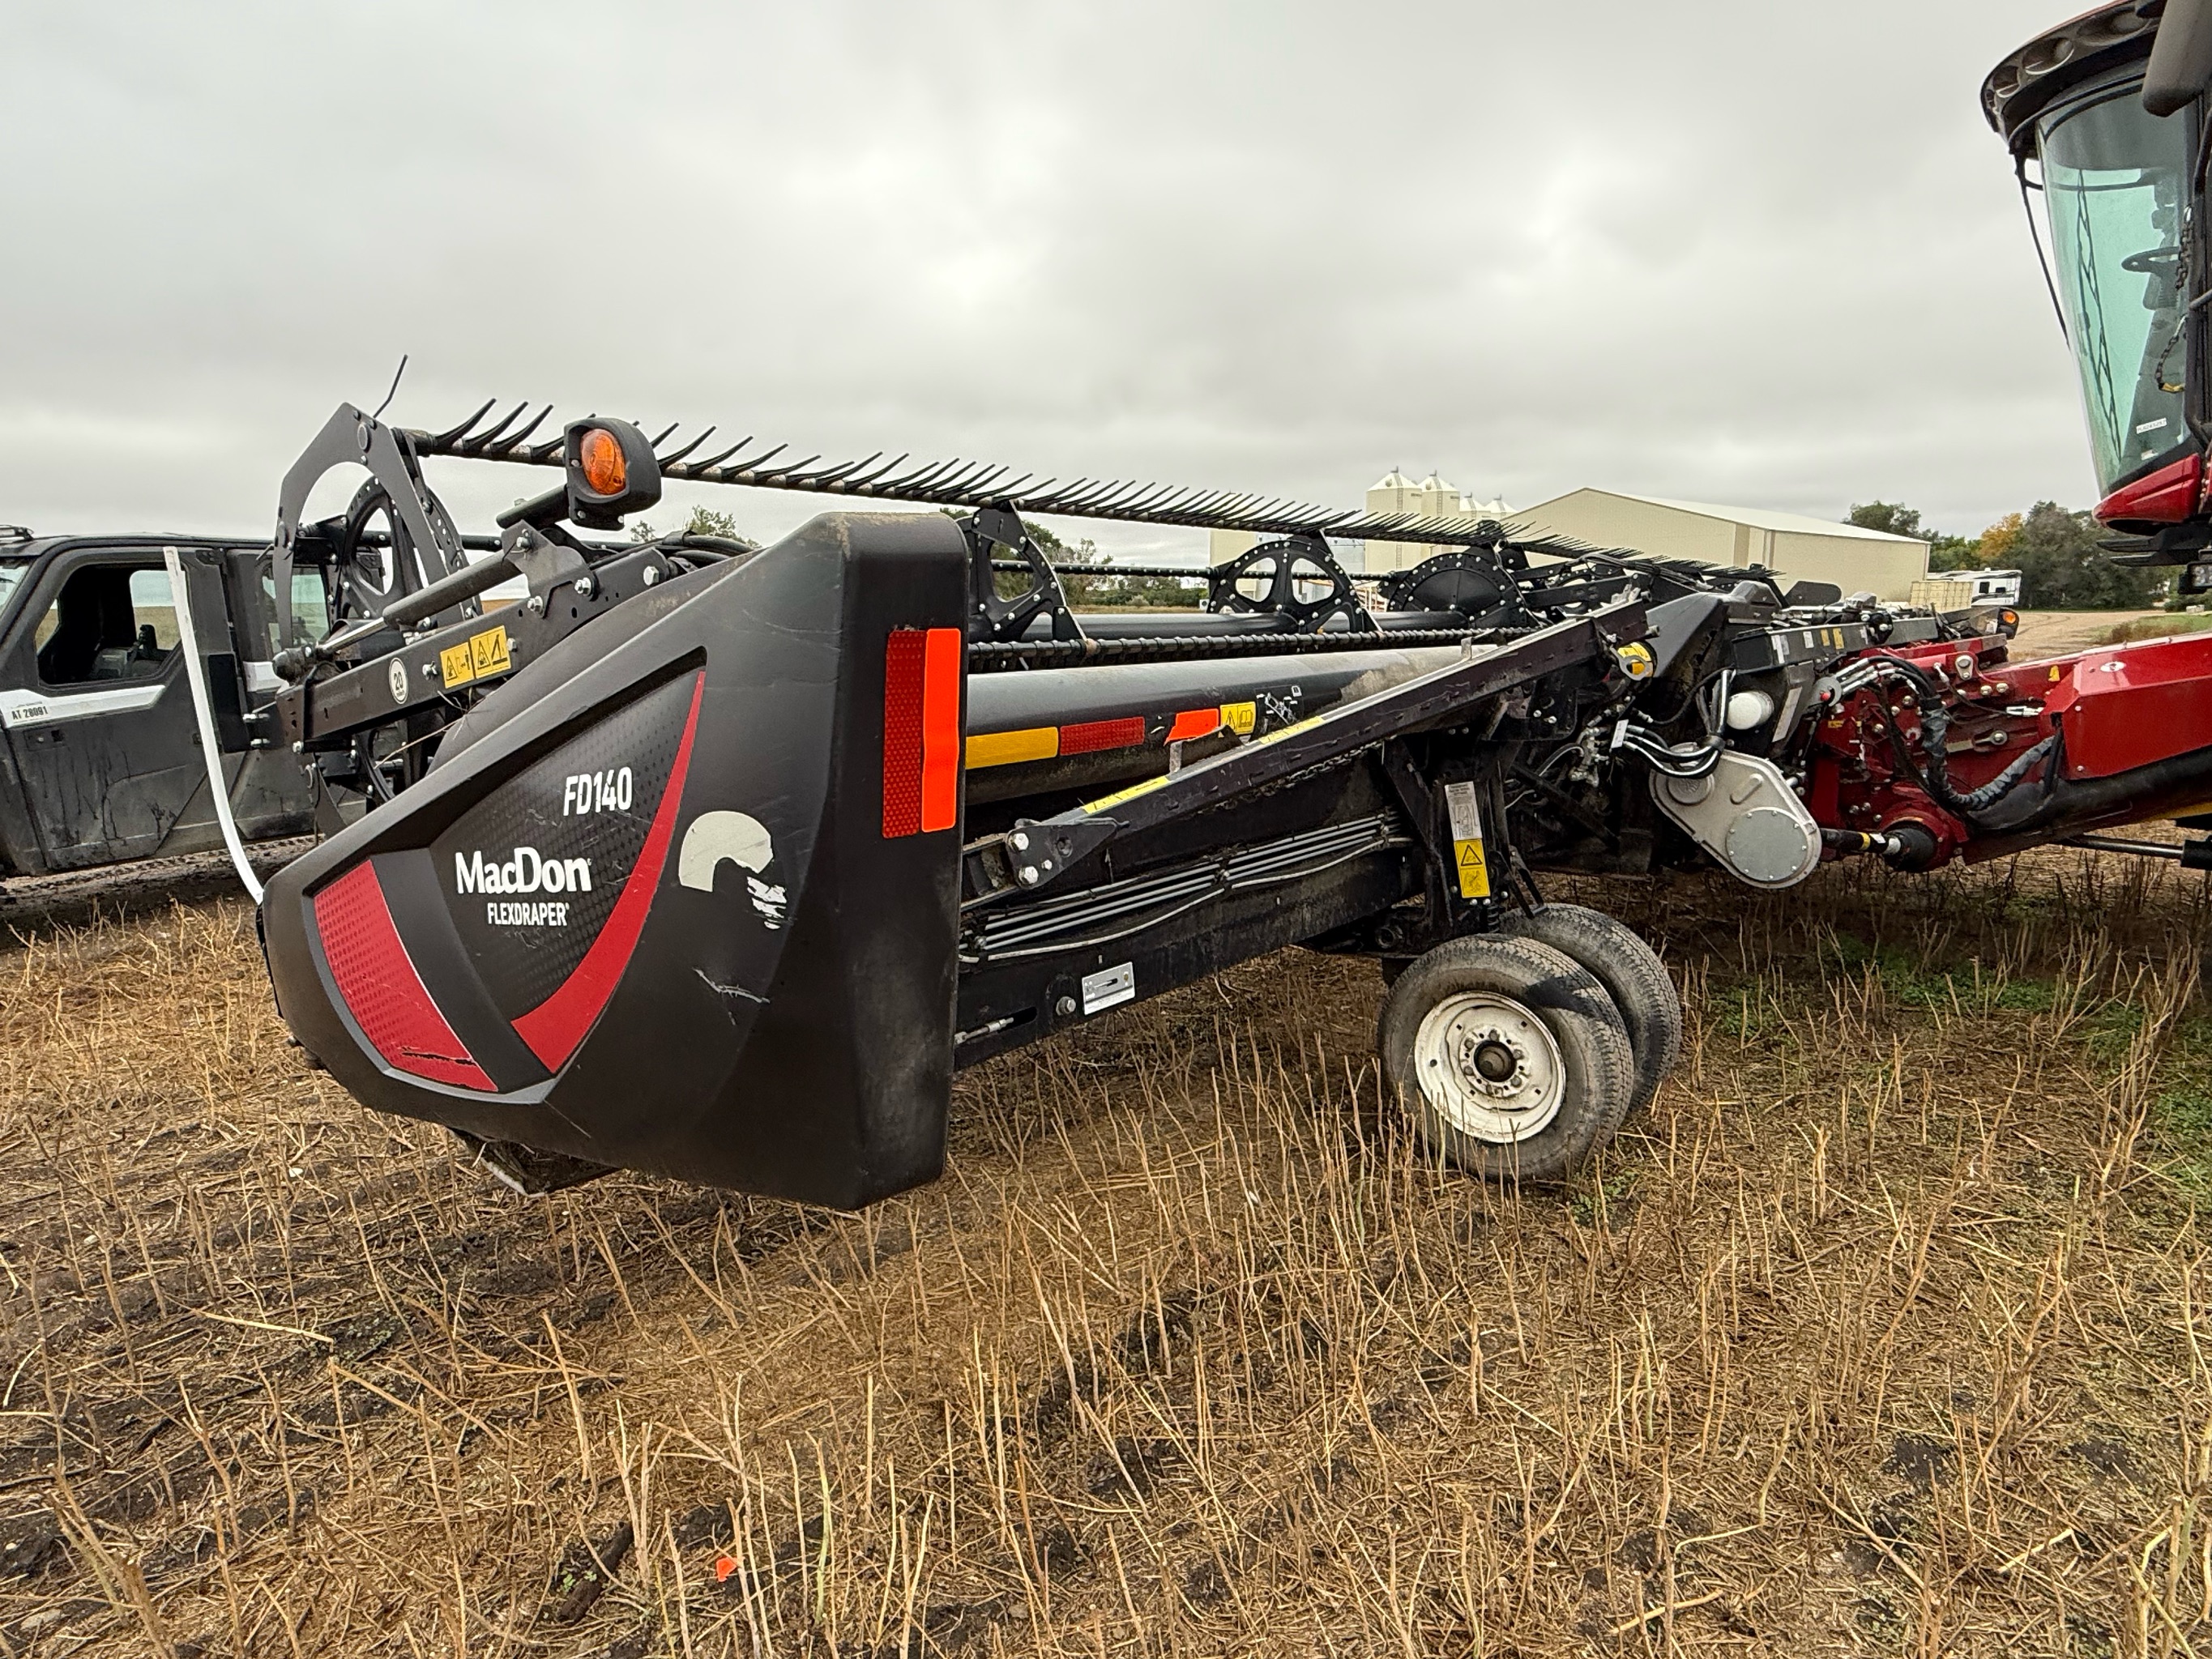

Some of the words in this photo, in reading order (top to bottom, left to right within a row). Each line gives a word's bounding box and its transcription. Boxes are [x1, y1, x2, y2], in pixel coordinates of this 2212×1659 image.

[394, 671, 404, 691] 20
[11, 710, 22, 720] AT
[23, 706, 49, 719] 28091
[563, 766, 633, 817] FD140
[455, 847, 592, 894] MacDon
[487, 902, 568, 927] FLEXDRAPER
